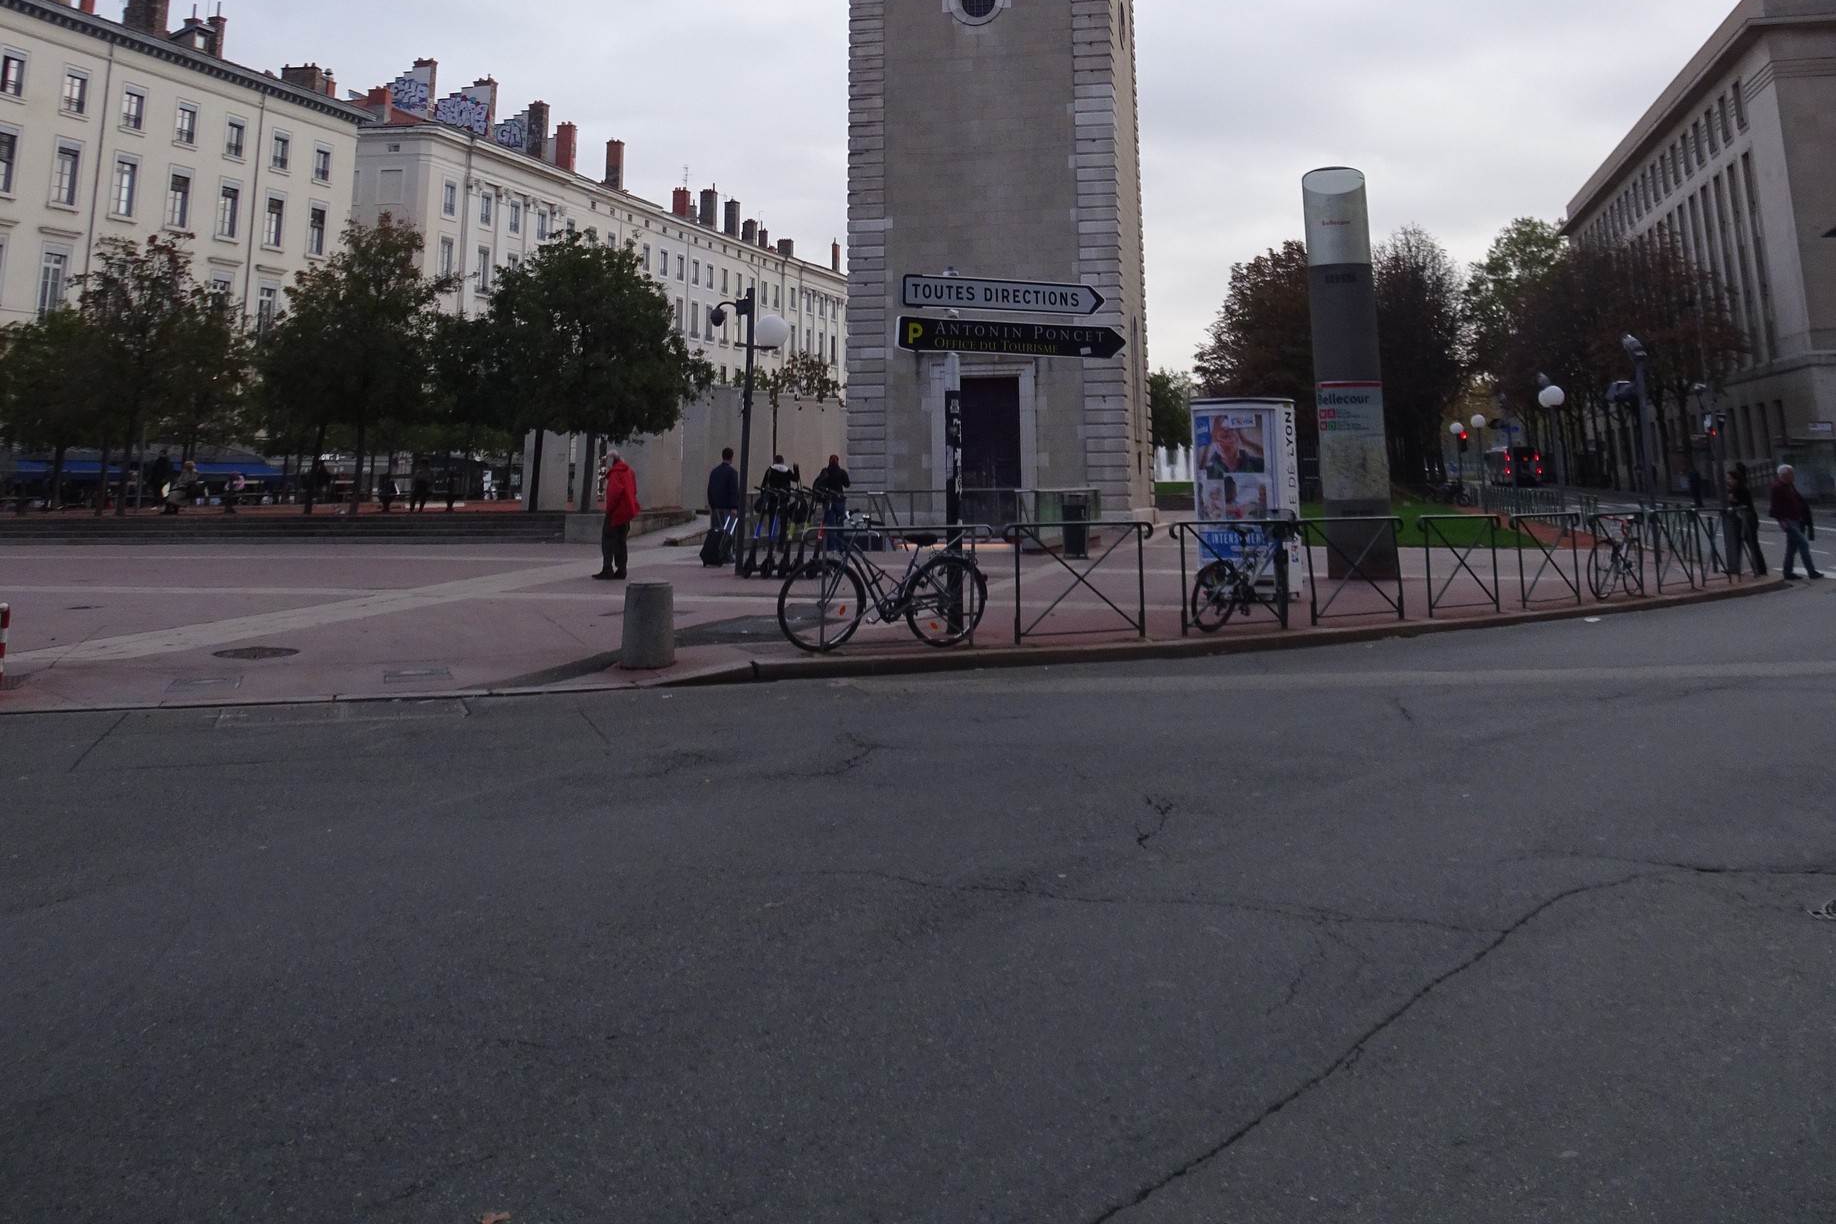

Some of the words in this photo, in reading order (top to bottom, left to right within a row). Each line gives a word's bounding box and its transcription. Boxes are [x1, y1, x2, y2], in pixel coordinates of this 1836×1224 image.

[911, 283, 976, 301] TOUTES
[984, 287, 1080, 307] DIRECTIONS
[908, 322, 923, 344] P
[935, 321, 1023, 338] ANTONIN
[1033, 325, 1105, 343] PONCET
[934, 336, 976, 350] OFFICE
[1000, 339, 1058, 354] TOURISME
[1318, 393, 1370, 406] Bellecour
[1284, 411, 1294, 457] LYON
